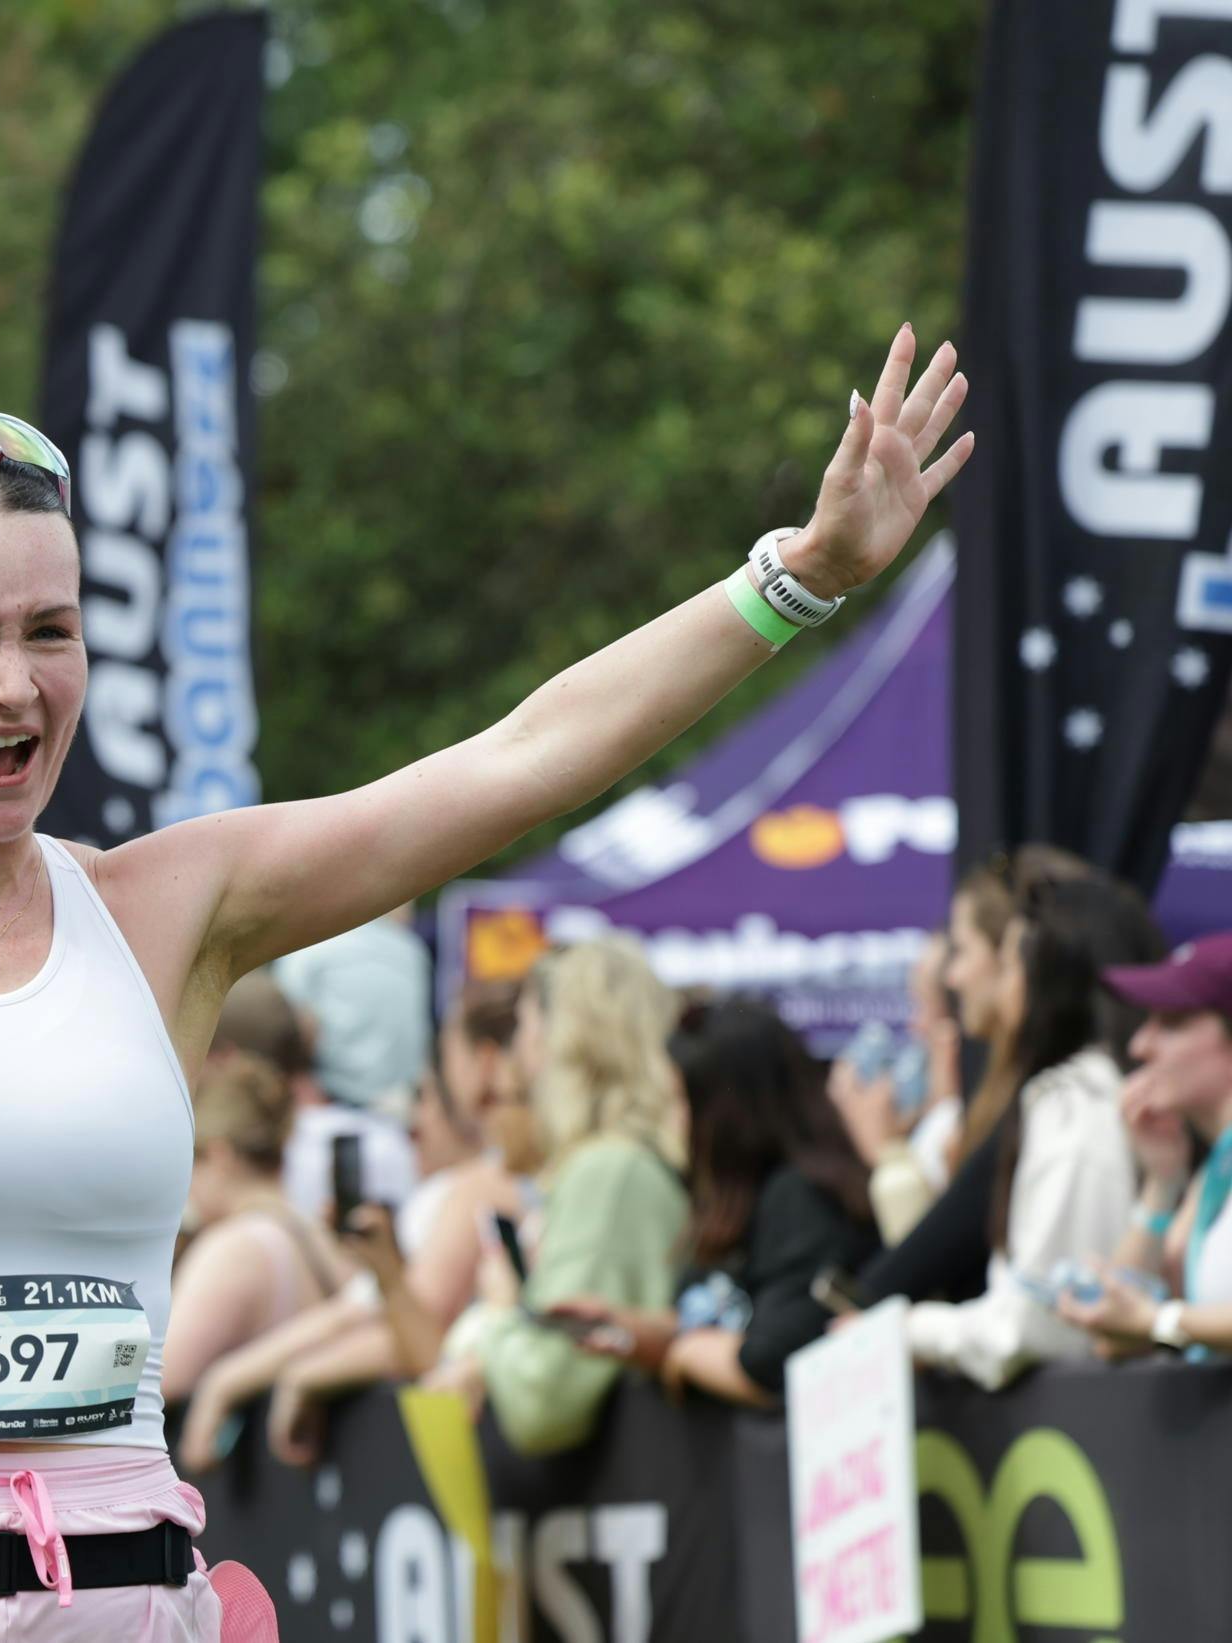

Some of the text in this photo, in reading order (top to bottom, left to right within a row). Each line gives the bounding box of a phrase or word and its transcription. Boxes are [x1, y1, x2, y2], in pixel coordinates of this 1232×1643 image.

[80, 322, 168, 790] AUST
[23, 1281, 123, 1304] 21.1KM
[76, 1412, 105, 1422] RUDY
